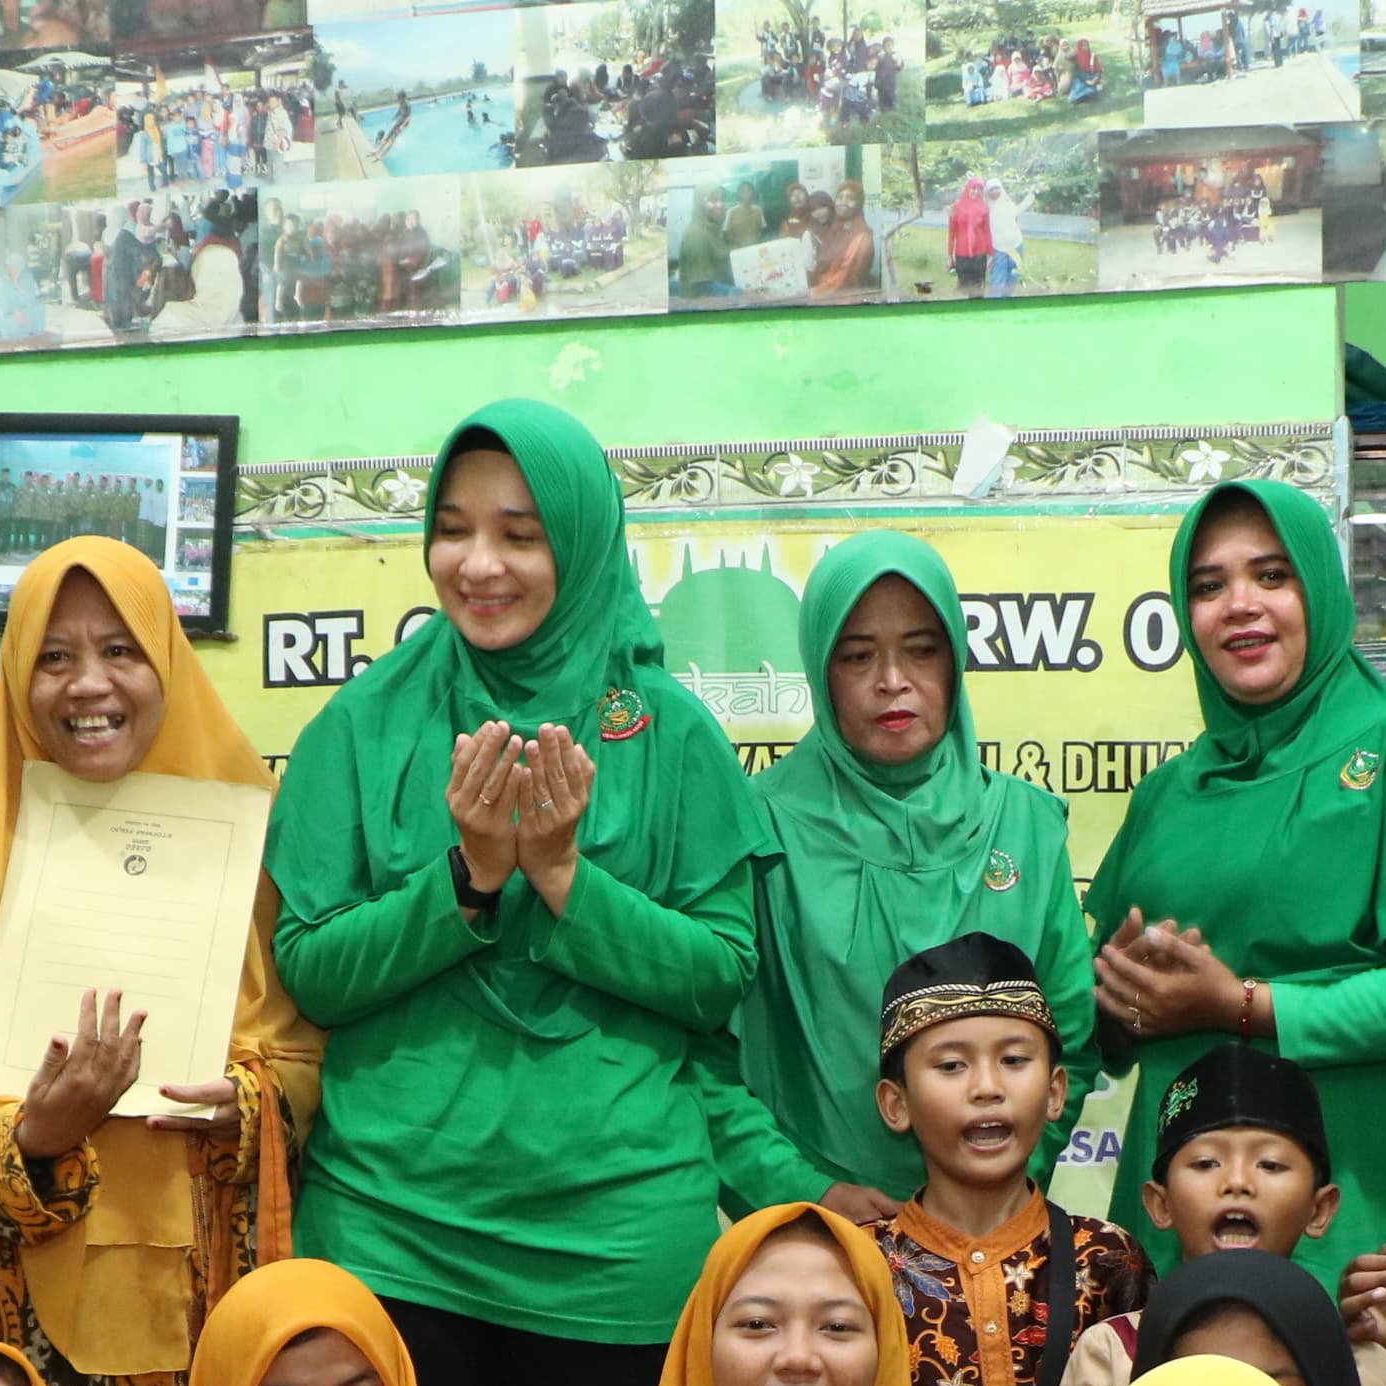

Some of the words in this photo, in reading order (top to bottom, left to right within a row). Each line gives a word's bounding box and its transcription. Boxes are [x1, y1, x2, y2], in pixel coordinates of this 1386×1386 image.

[959, 592, 1103, 673] RW.
[1124, 591, 1185, 672] 0
[677, 660, 810, 715] kah
[1013, 741, 1054, 793] &
[1063, 741, 1195, 793] DHU
[1057, 1130, 1122, 1163] SA
